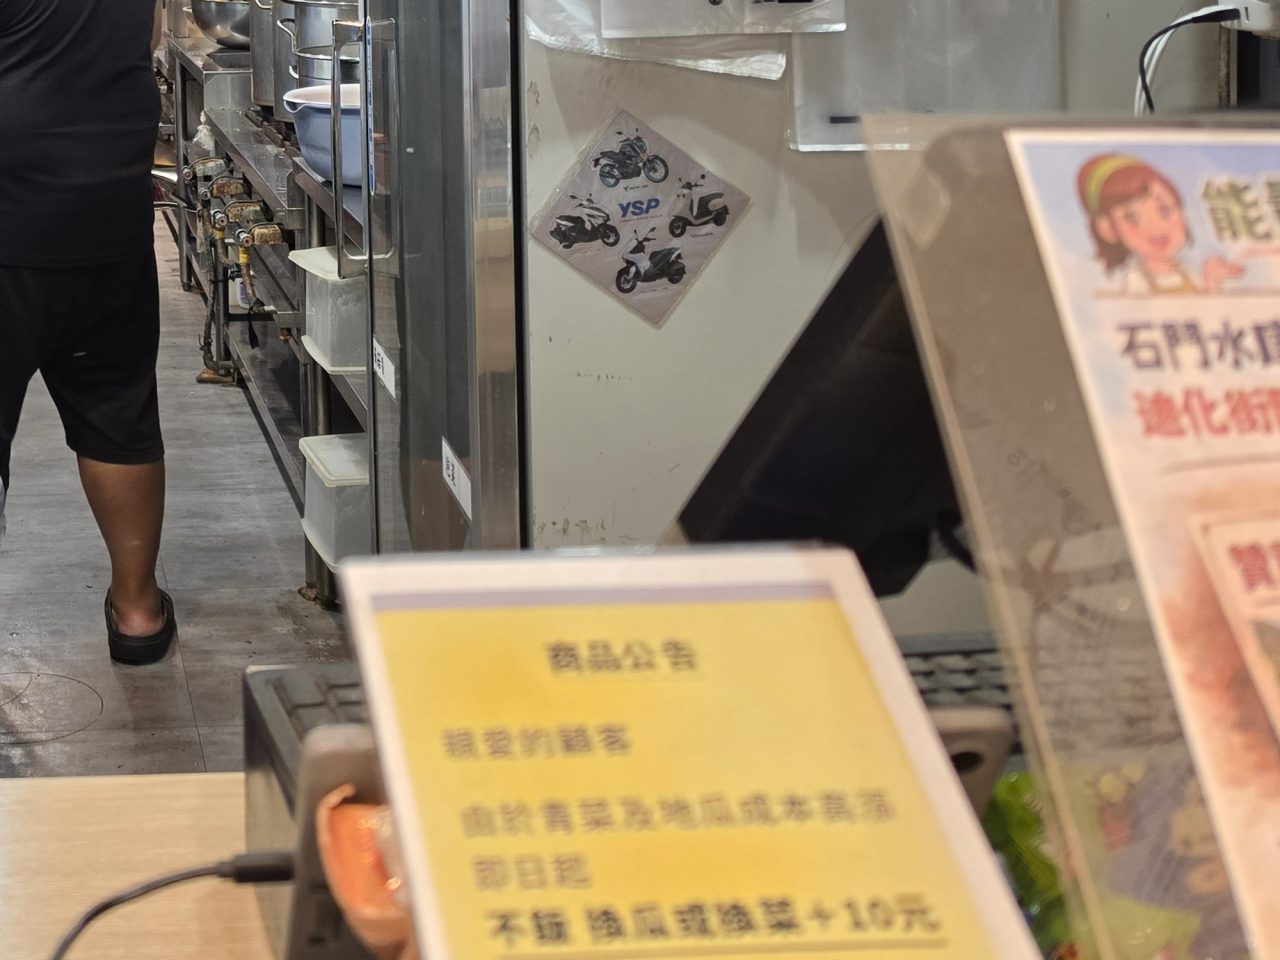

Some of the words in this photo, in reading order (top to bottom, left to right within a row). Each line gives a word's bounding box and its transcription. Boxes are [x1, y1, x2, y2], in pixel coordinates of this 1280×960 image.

[618, 198, 660, 218] YSP
[1202, 177, 1280, 243] 能
[547, 640, 697, 674] 商品公告
[442, 724, 630, 760] 親愛的顧客
[472, 851, 592, 891] 即日起
